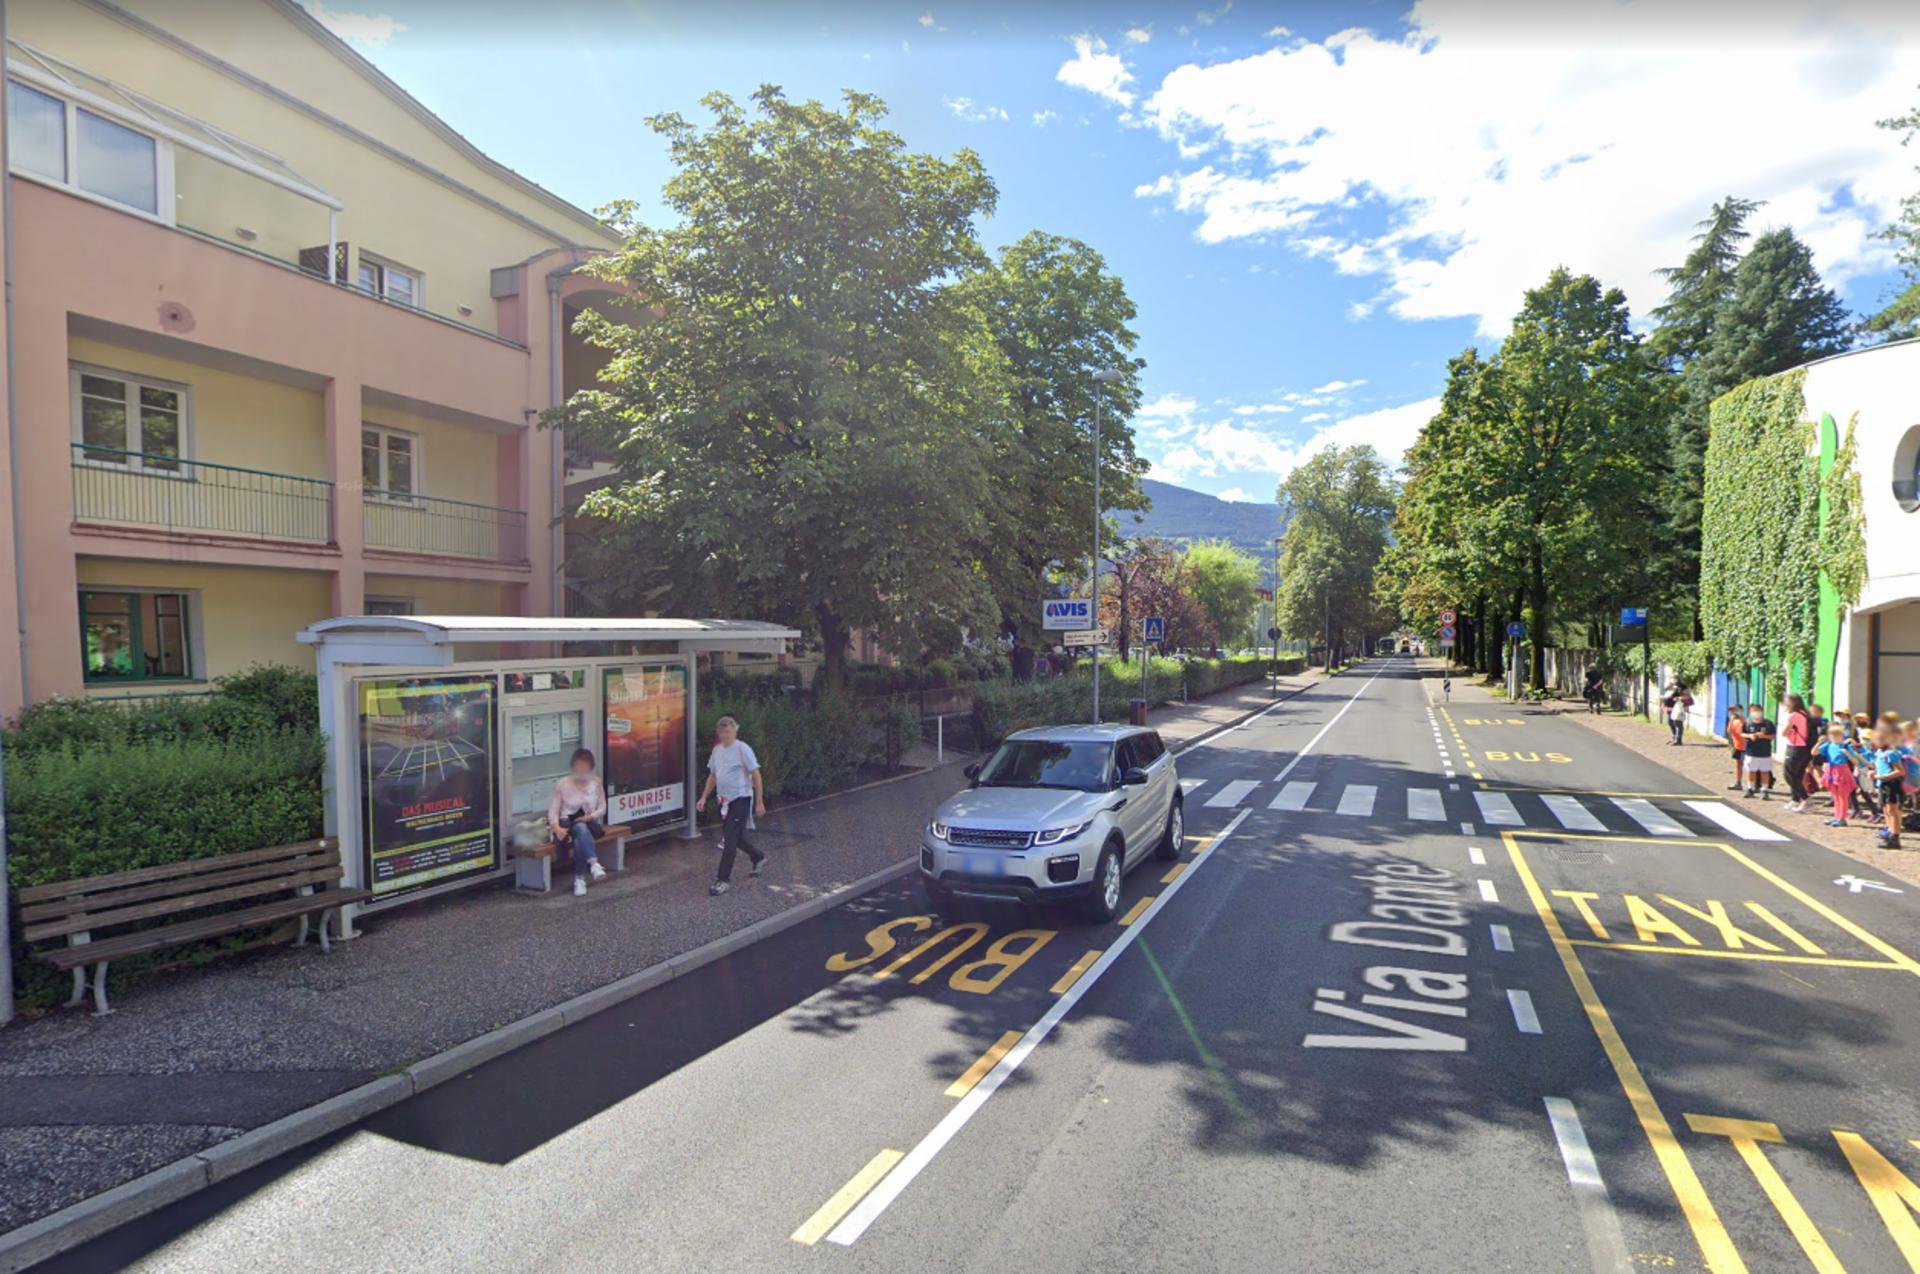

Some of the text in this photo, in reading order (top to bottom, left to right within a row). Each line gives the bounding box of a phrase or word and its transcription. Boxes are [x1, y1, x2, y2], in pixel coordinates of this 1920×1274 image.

[1046, 602, 1088, 617] AVIS
[1464, 718, 1527, 726] BUS
[1485, 751, 1574, 763] BUS
[424, 796, 464, 813] MUSICAL
[618, 787, 673, 811] SUNRISE
[1551, 889, 1827, 956] TAXI
[825, 915, 1059, 995] BUS
